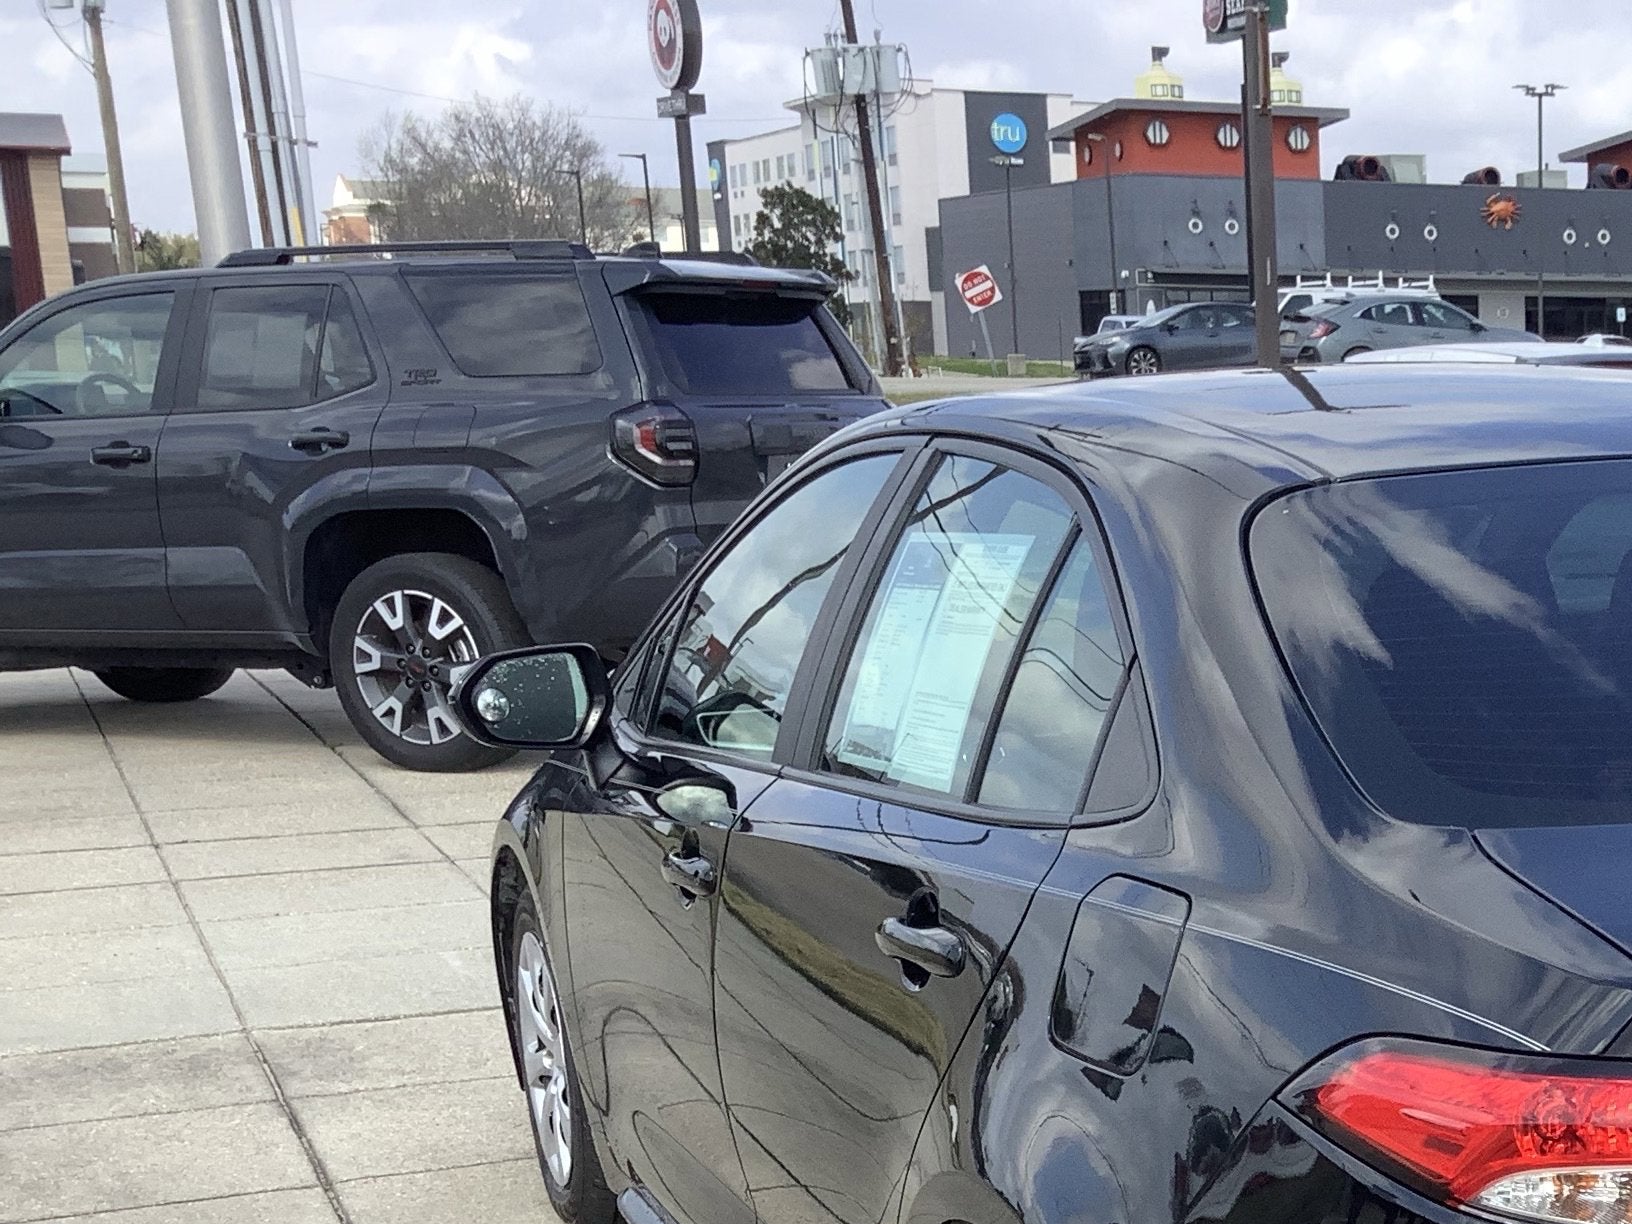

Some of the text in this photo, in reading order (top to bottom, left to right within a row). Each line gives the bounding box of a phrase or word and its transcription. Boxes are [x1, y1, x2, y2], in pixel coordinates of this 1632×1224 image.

[991, 121, 1020, 142] tru
[963, 274, 986, 290] DO NOT
[972, 290, 993, 304] ENTER
